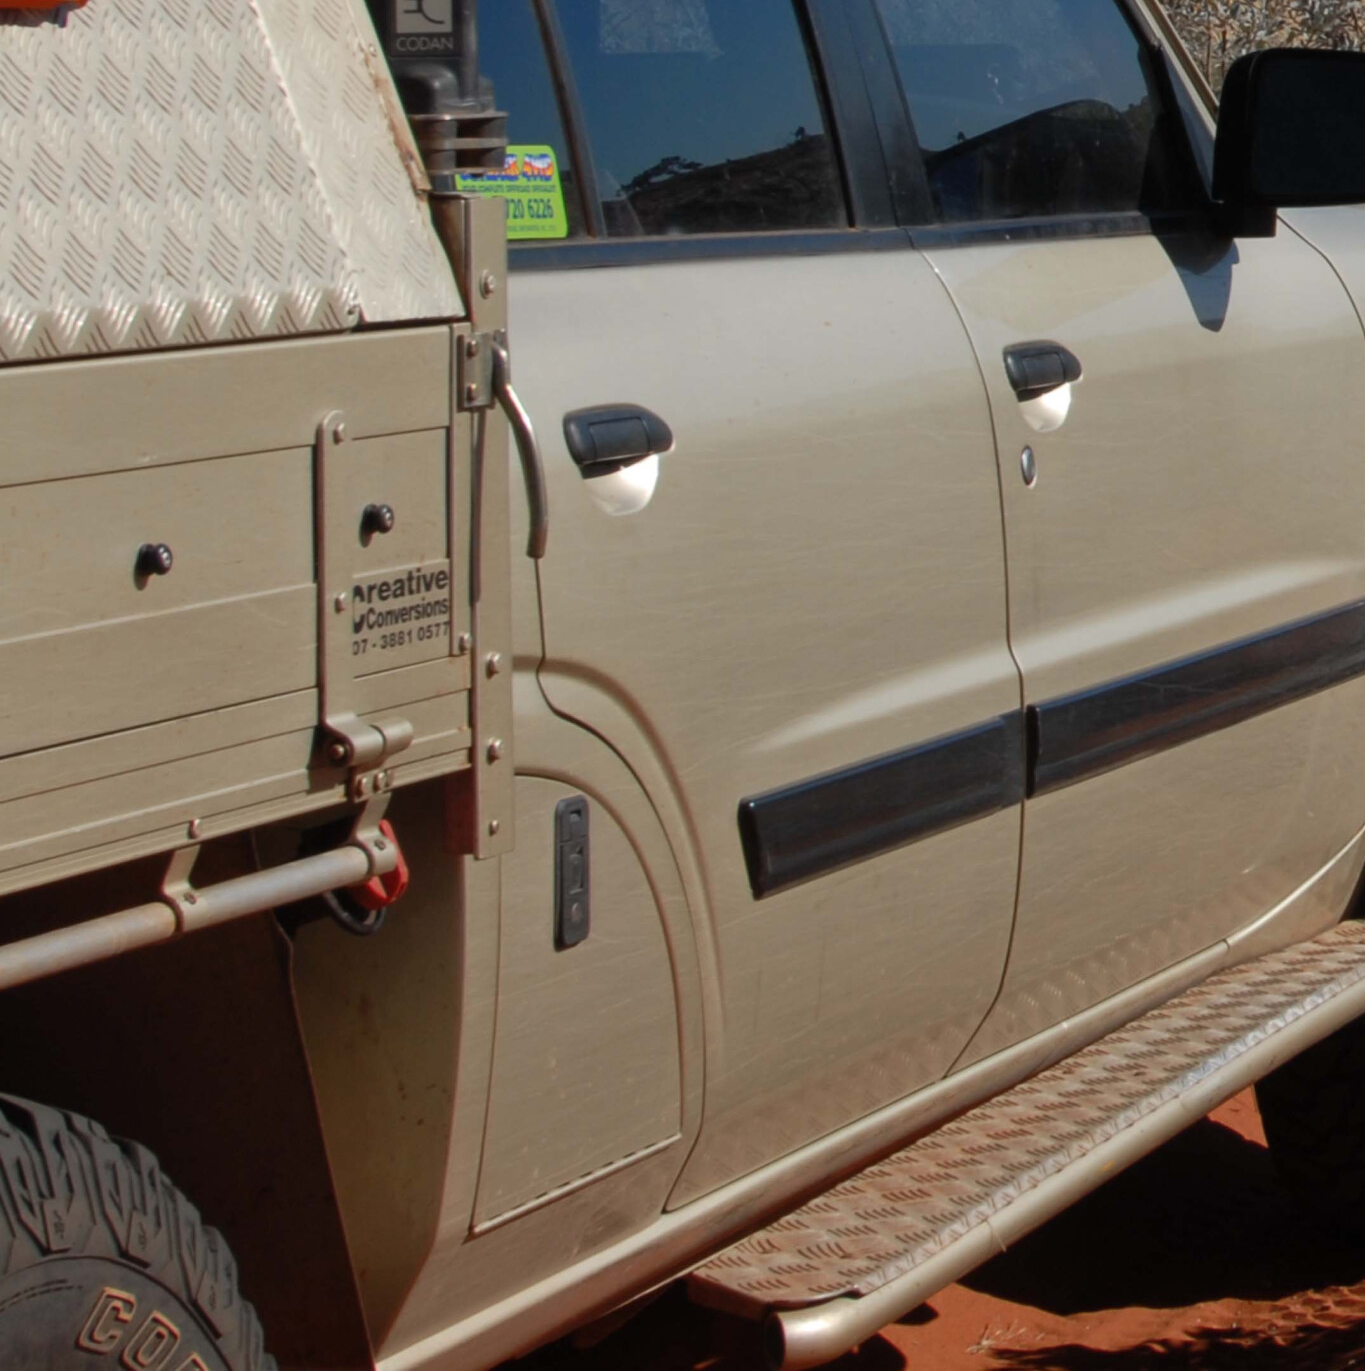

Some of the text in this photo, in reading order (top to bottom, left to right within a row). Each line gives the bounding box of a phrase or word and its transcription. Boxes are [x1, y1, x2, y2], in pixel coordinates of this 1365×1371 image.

[396, 37, 454, 51] CODAN
[366, 597, 449, 630] Conversions
[380, 630, 413, 650] 3881
[417, 621, 450, 641] 0577
